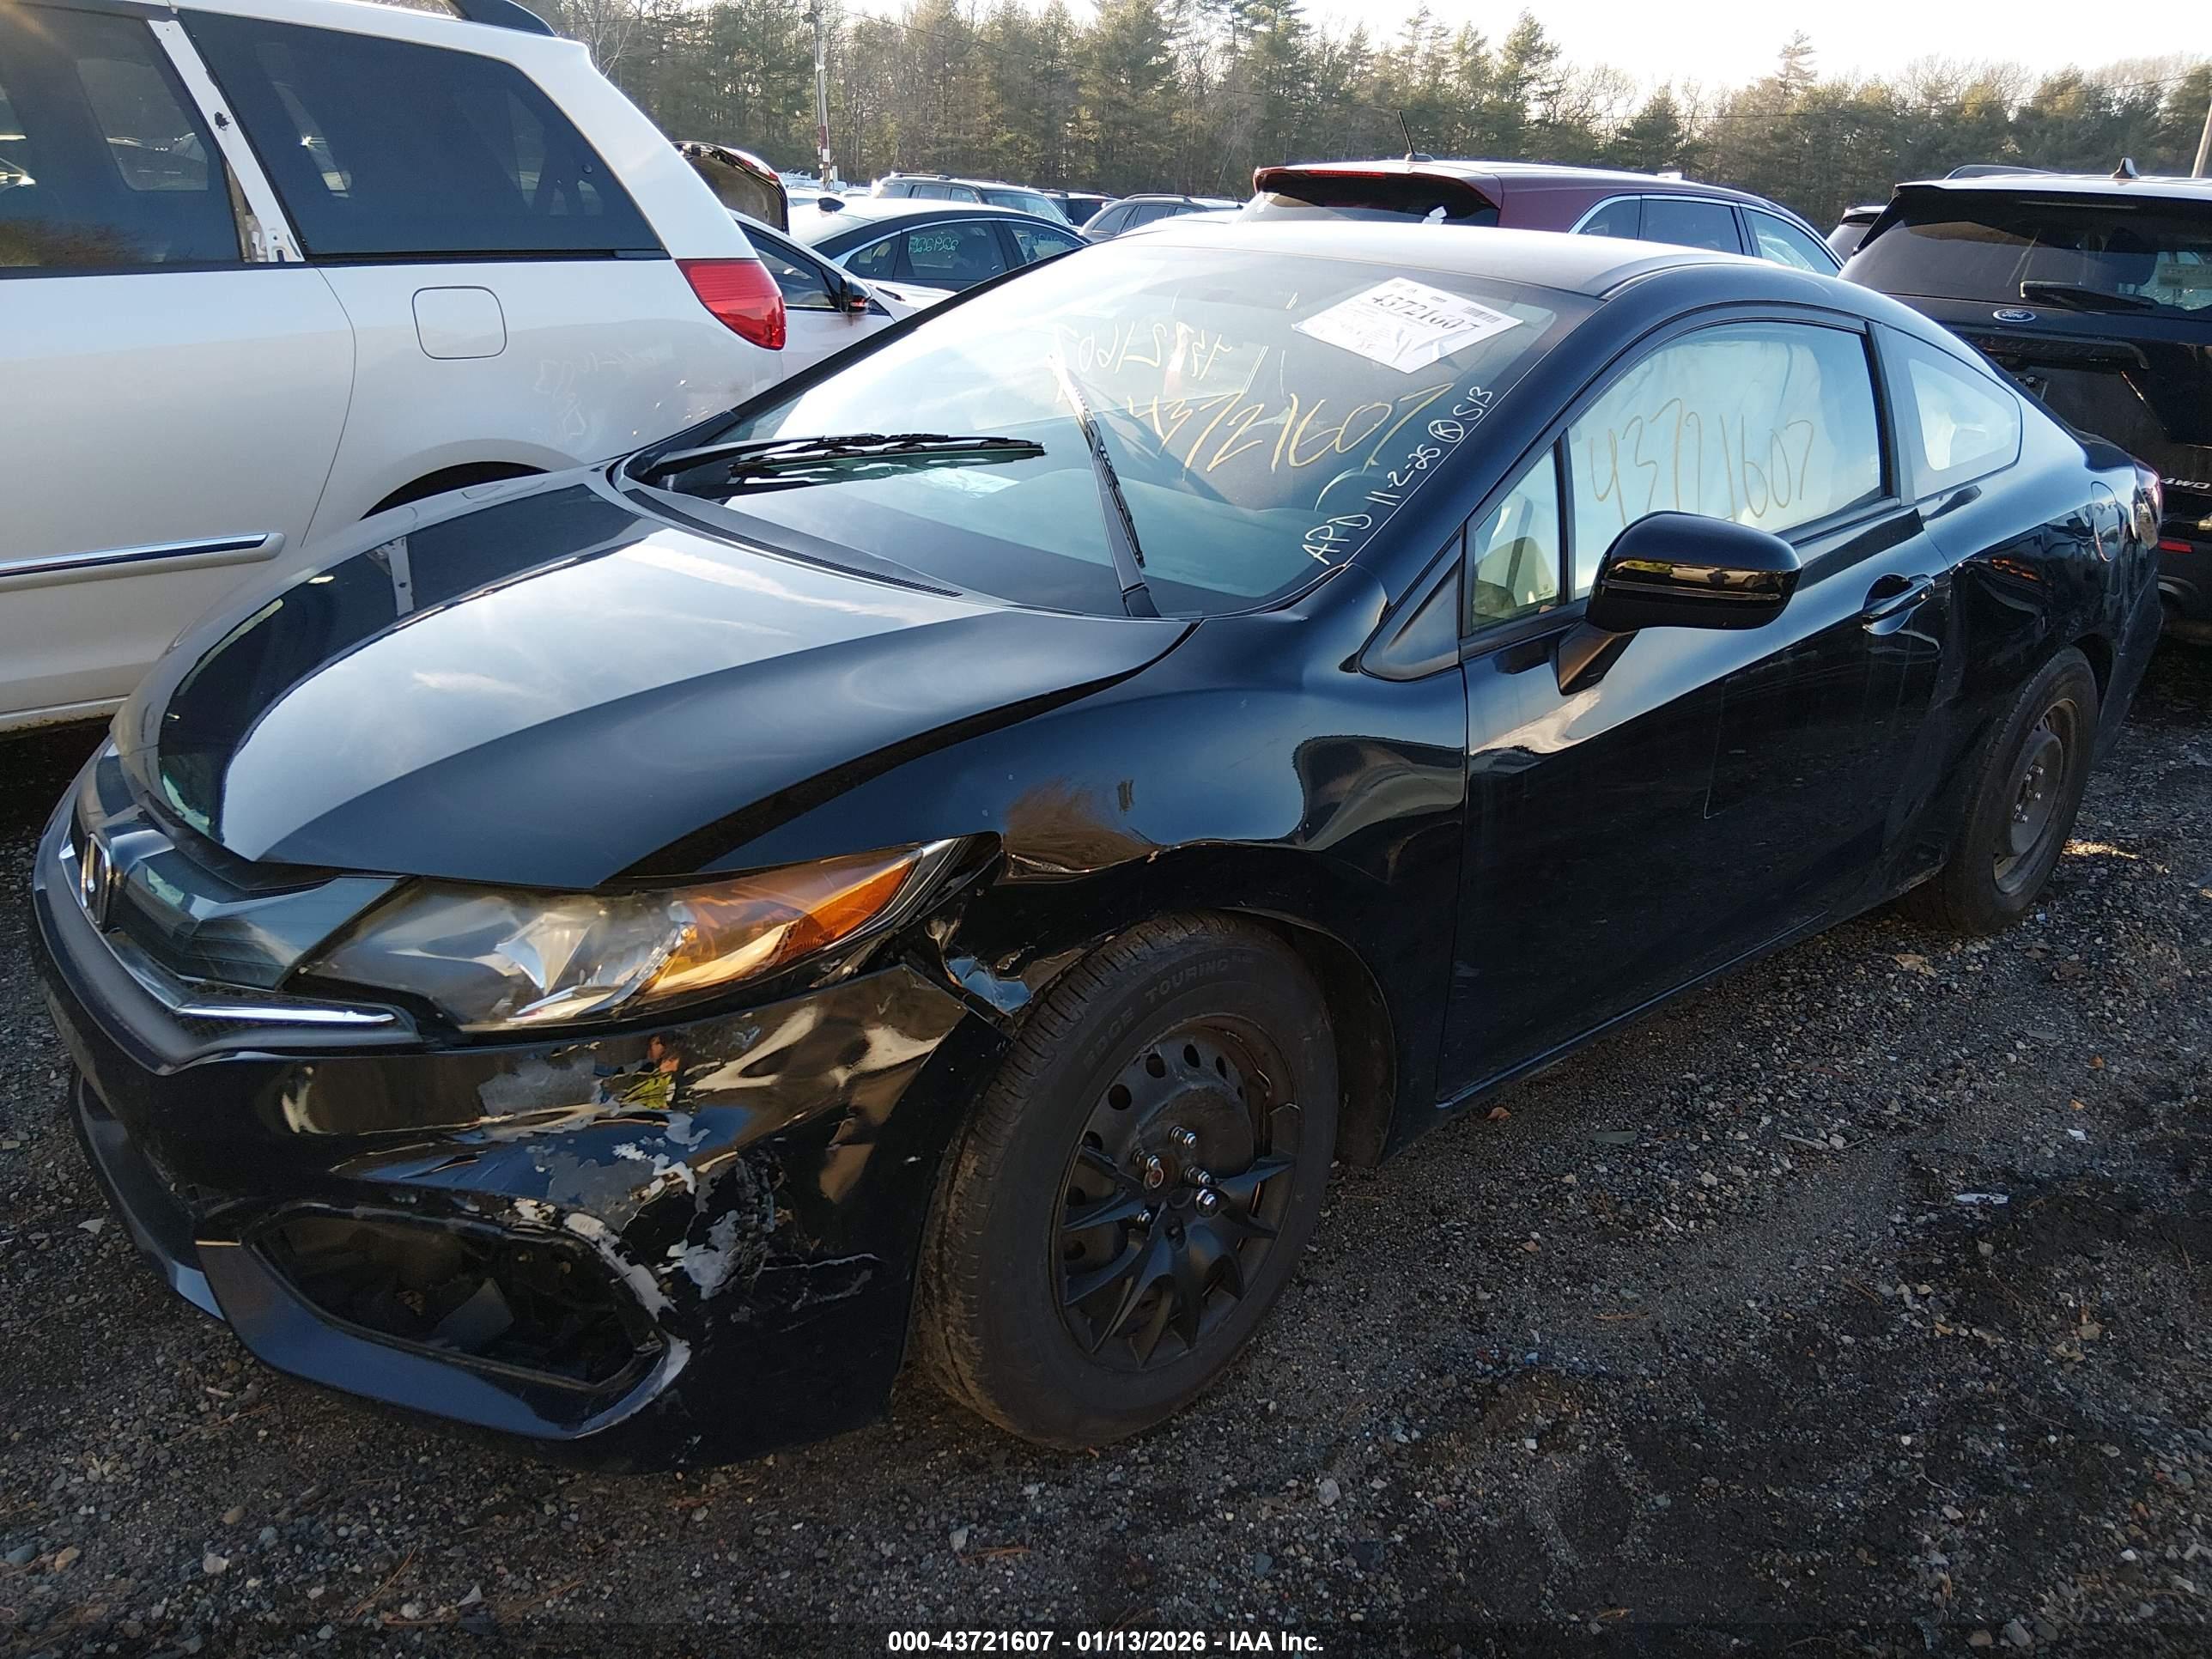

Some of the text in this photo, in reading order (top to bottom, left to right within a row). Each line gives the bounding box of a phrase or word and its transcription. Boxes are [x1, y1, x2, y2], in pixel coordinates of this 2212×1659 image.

[1371, 294, 1480, 330] 43721607
[1127, 382, 1455, 482] 43721607
[2160, 477, 2211, 489] 4WD
[1145, 957, 1229, 1003] TOURING
